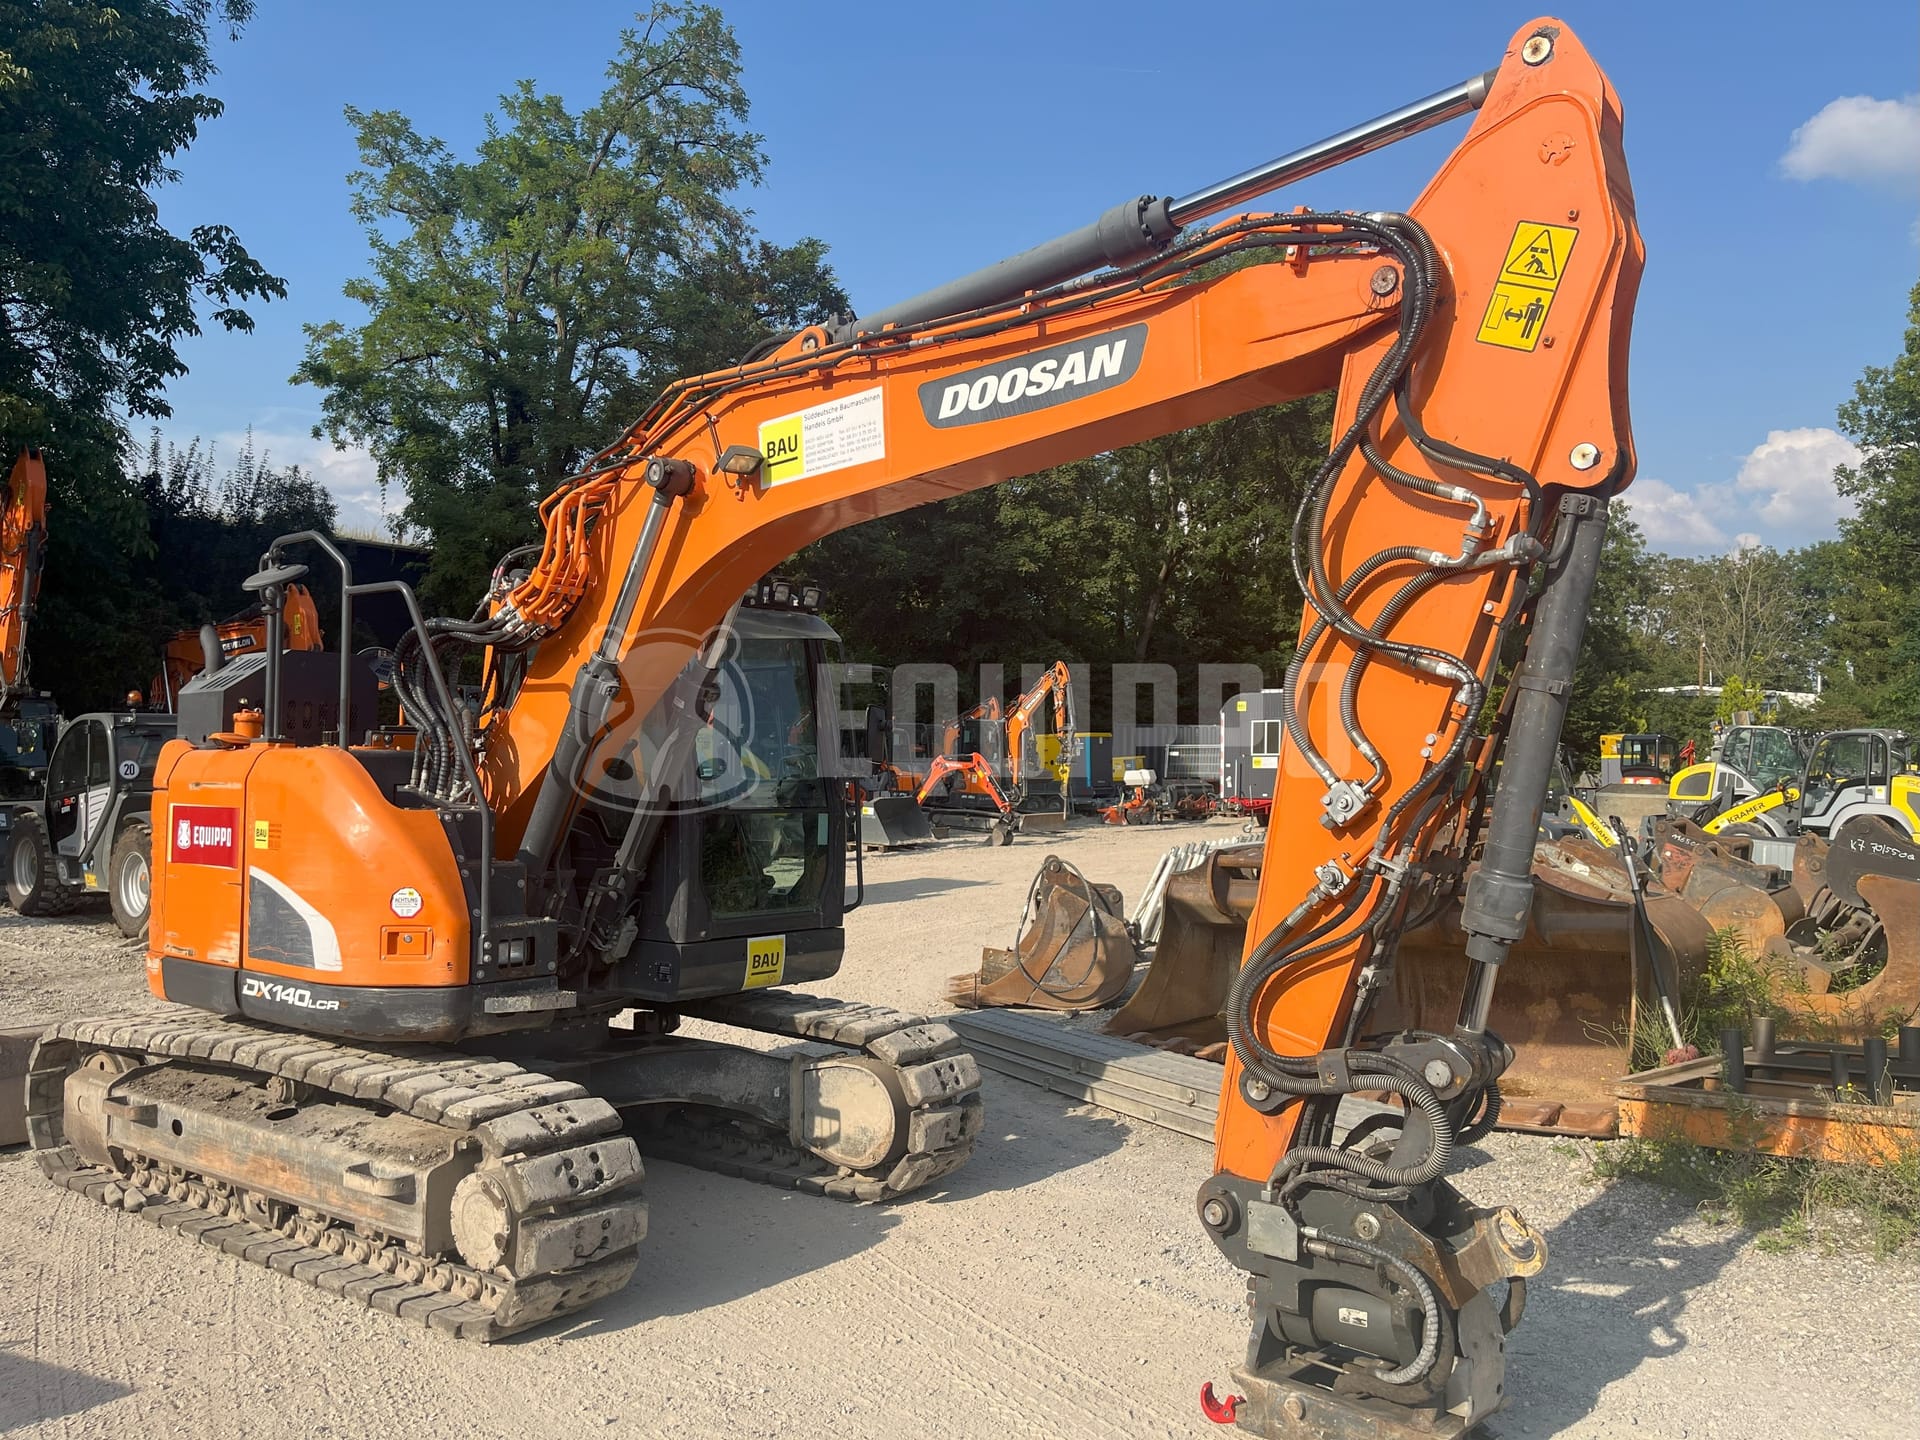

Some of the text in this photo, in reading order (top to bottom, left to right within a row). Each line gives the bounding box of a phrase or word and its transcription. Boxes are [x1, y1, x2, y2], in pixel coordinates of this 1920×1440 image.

[937, 339, 1127, 420] DOOSAN
[840, 393, 881, 411] Baumaschinen
[827, 414, 844, 425] GmbH
[766, 434, 798, 459] BAU
[123, 763, 135, 776] 20
[1726, 801, 1766, 824] KRAMER
[193, 825, 232, 848] EQUIPPO
[255, 828, 267, 838] BAU
[752, 952, 780, 969] BAU
